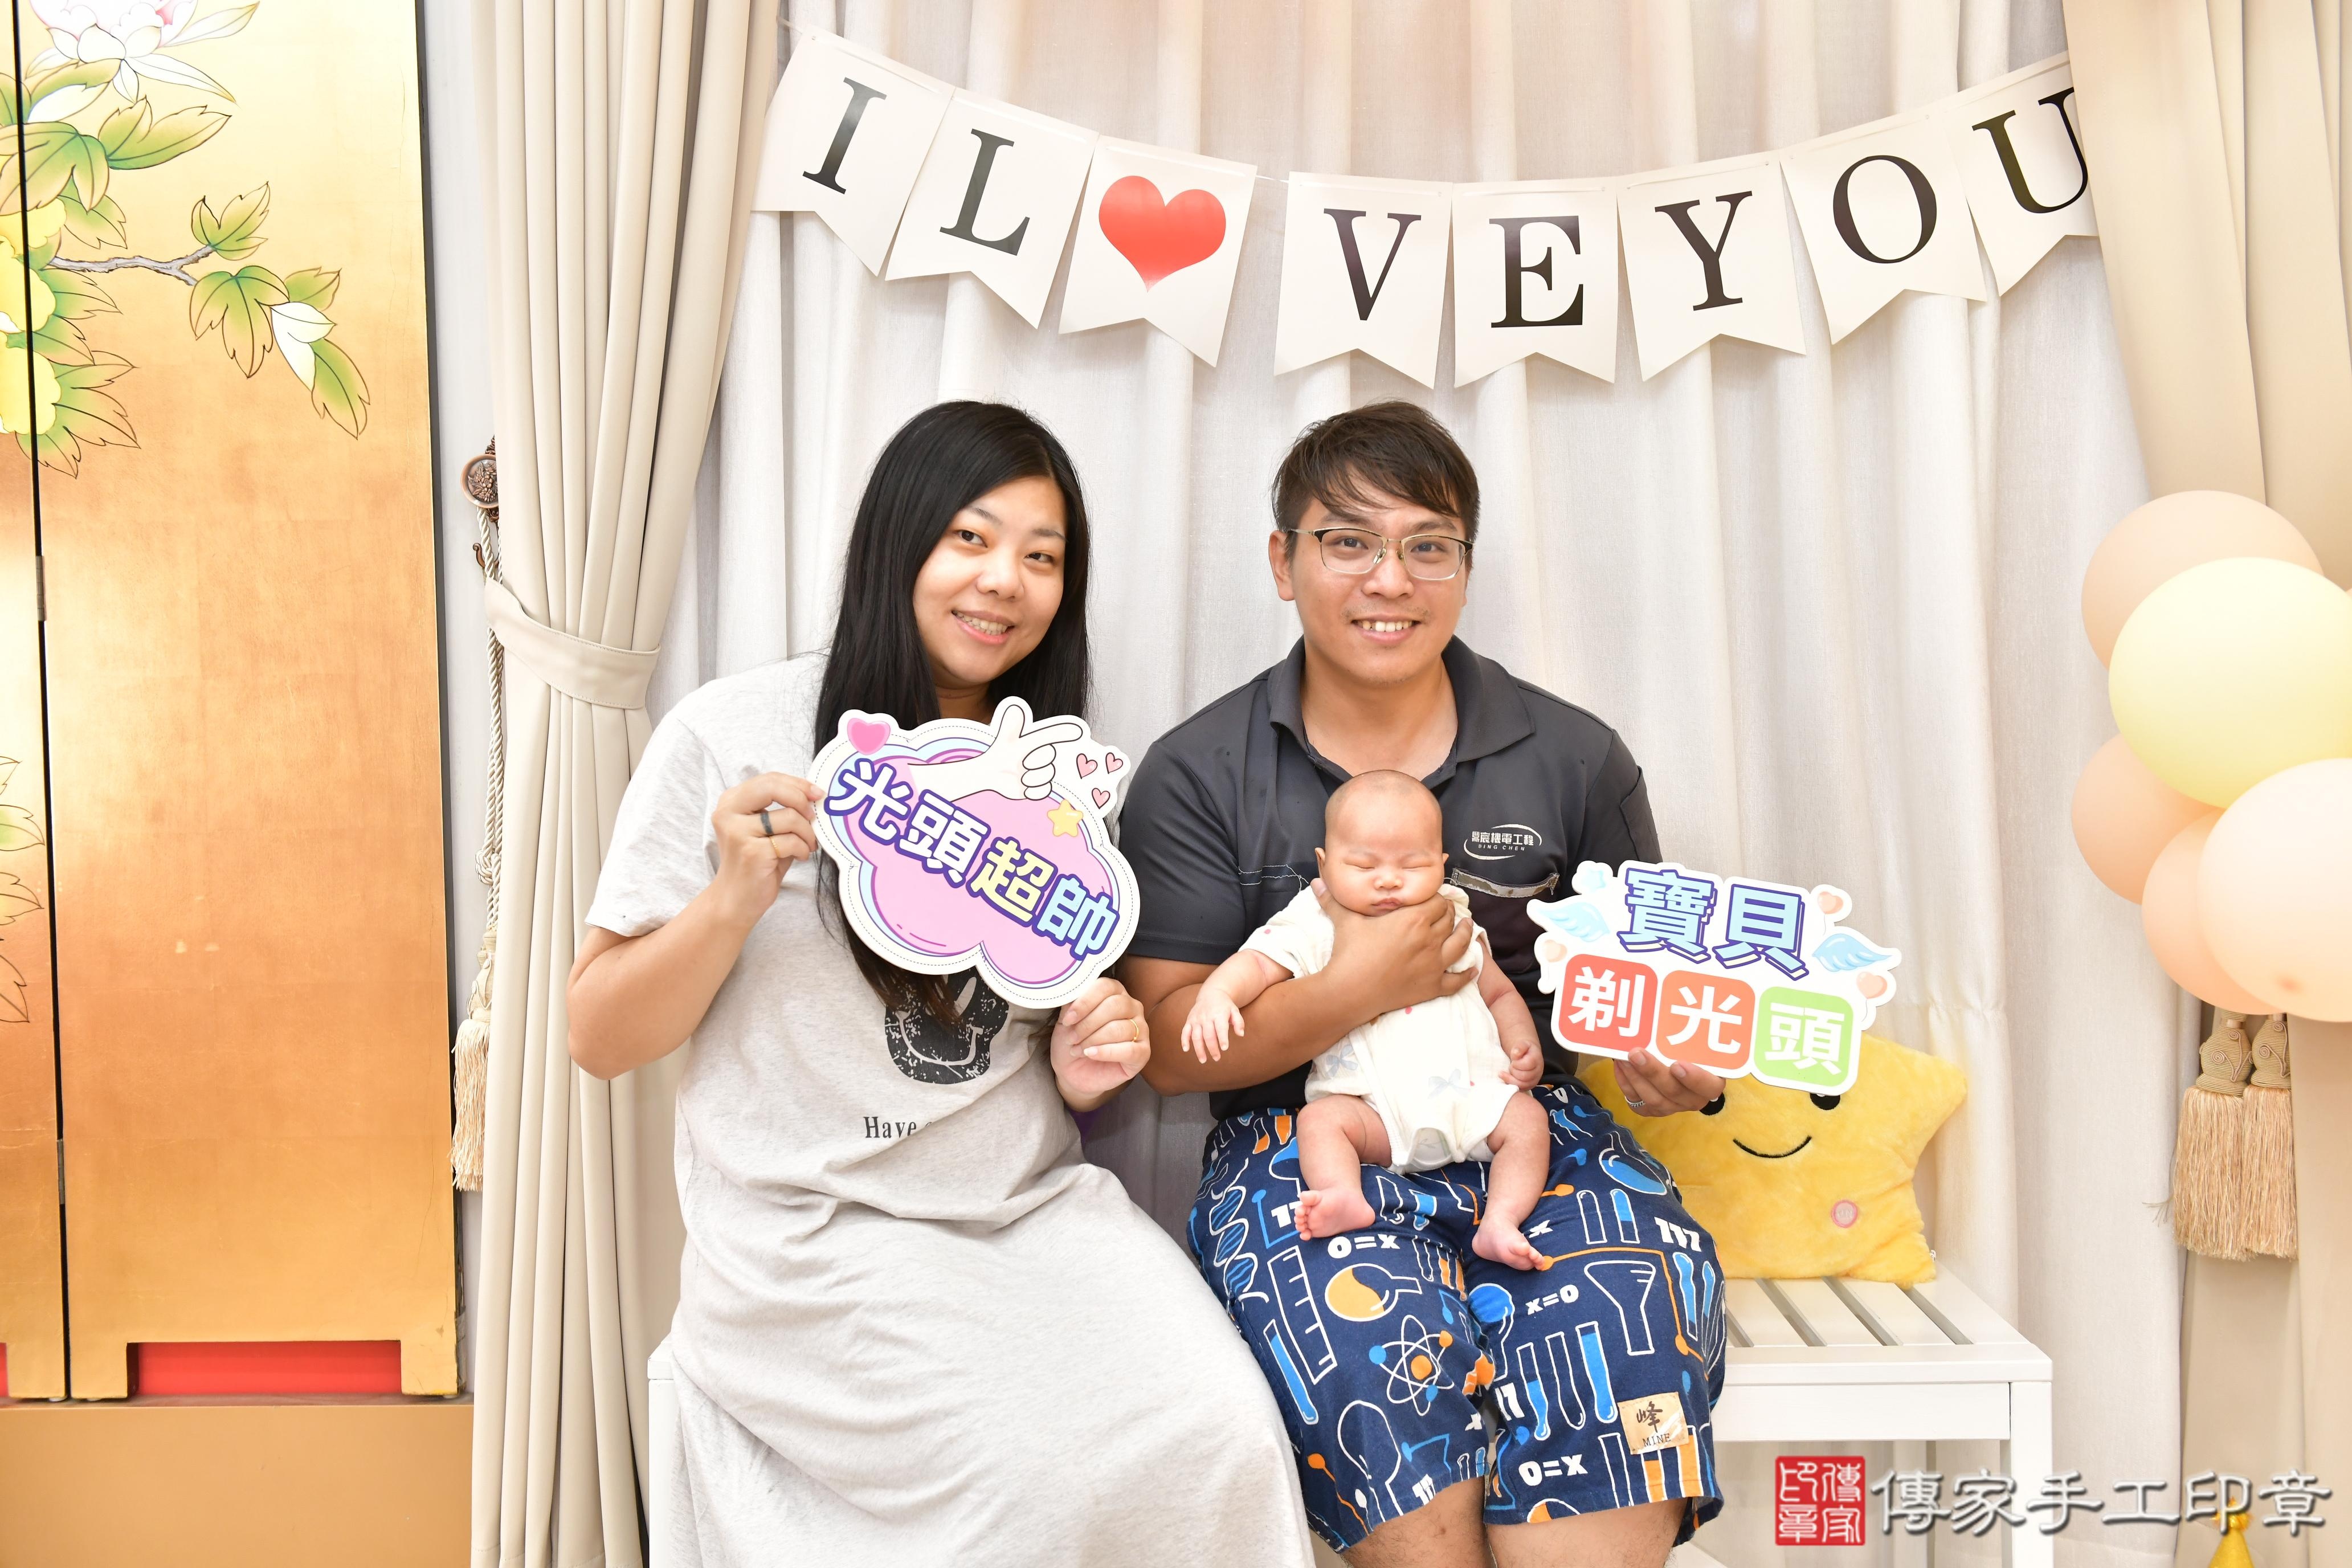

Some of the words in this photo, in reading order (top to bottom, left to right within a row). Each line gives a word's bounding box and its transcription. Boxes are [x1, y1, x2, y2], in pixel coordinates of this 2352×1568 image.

[824, 758, 1120, 961] 光頭超帥
[1616, 867, 1810, 981] 寶貝
[1567, 965, 1845, 1076] 剃光頭
[863, 1116, 917, 1138] Have
[1636, 1400, 1663, 1433] 峰
[1642, 1433, 1671, 1447] MINE
